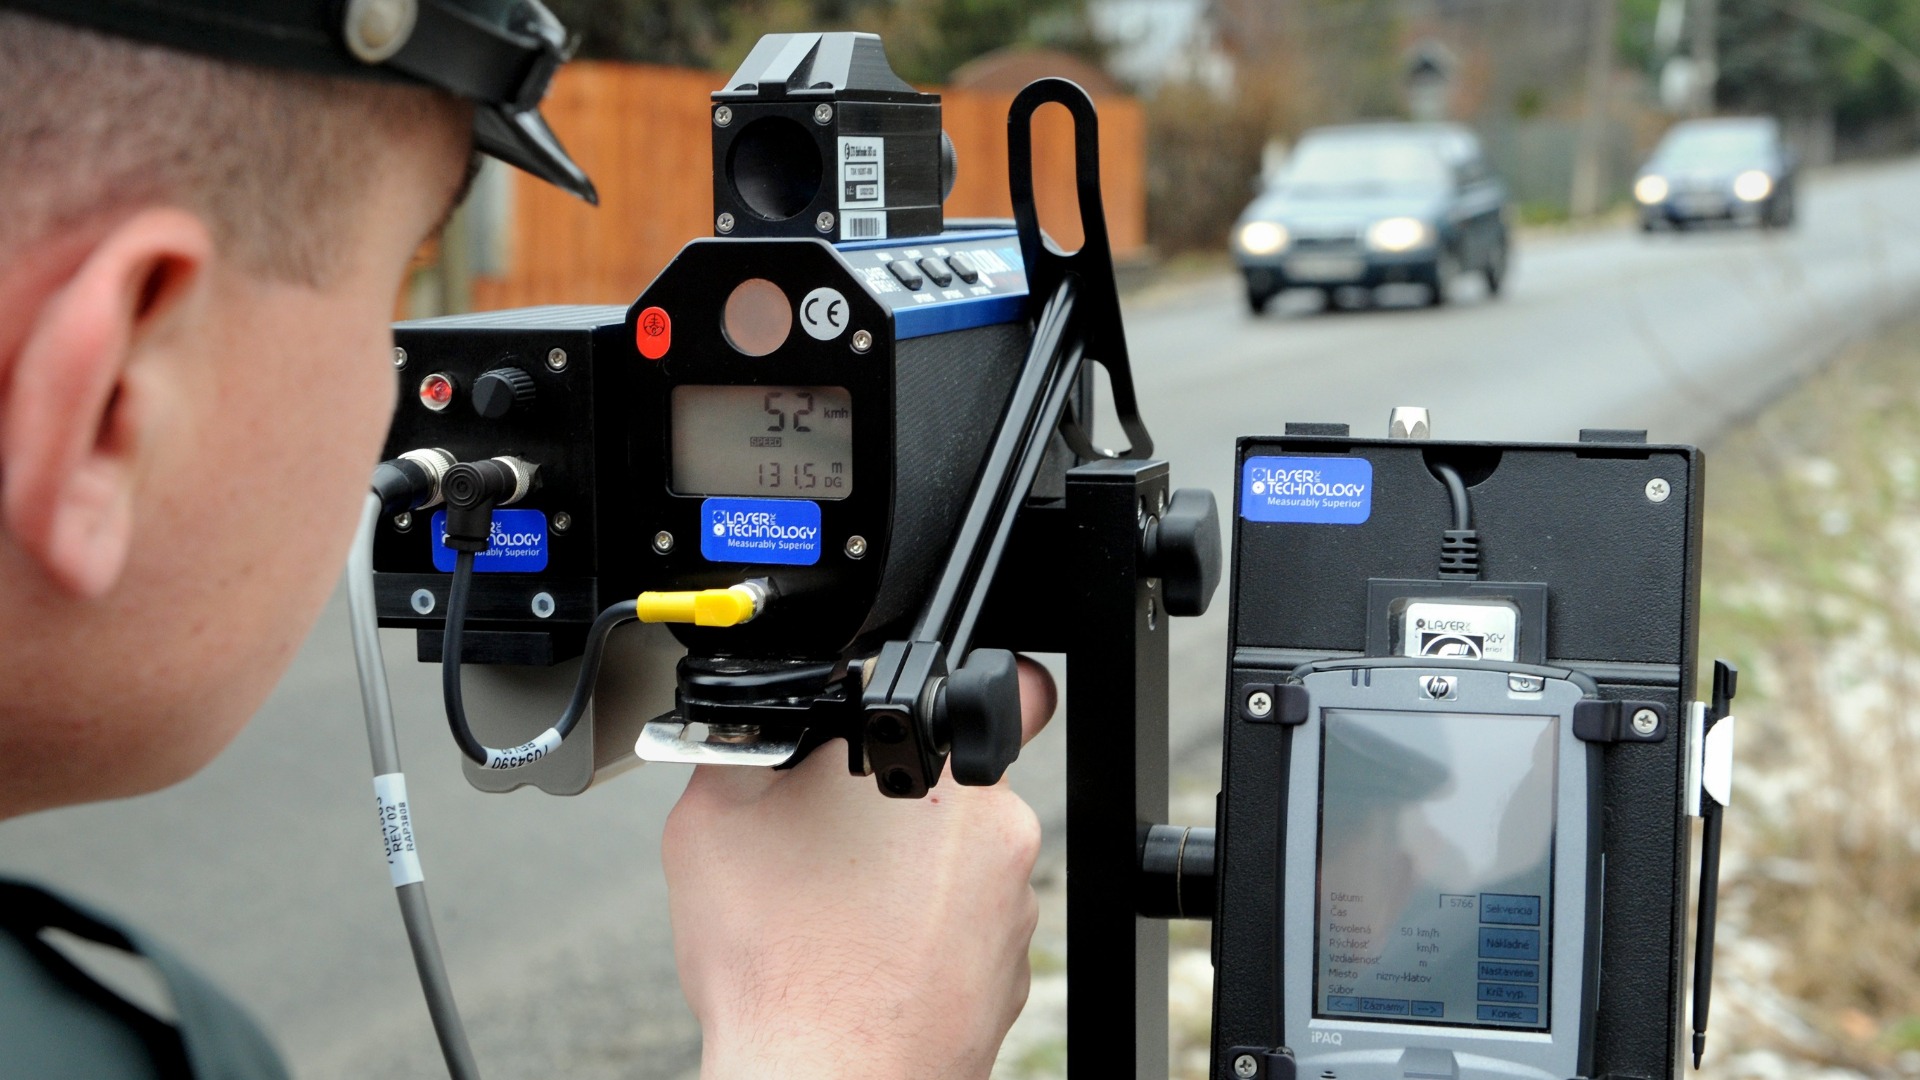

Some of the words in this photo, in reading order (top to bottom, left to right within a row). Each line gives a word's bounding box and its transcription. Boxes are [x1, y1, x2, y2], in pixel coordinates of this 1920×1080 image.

[805, 297, 841, 328] CE
[764, 391, 813, 432] 52
[823, 407, 848, 419] kmh
[750, 436, 782, 447] SPEED
[831, 461, 842, 474] m
[824, 476, 842, 488] DG
[1267, 469, 1314, 483] LASER
[1267, 481, 1365, 497] TECHNOLOGY
[1267, 497, 1320, 508] Measurably
[1322, 498, 1362, 509] Superior
[726, 511, 770, 525] LASER
[726, 524, 817, 539] TECHNOLOGY
[727, 538, 777, 550] Measurably
[778, 540, 815, 551] Superior
[505, 547, 540, 558] Superior
[1427, 620, 1466, 631] LASER
[385, 805, 397, 820] 02
[388, 825, 403, 853] REV
[1329, 923, 1372, 935] Povolená
[1401, 927, 1413, 937] 50
[1416, 927, 1440, 939] km/h
[1416, 942, 1440, 954] km/h
[1328, 968, 1359, 979] Miesto
[1481, 966, 1534, 978] Nastavenie
[1491, 1009, 1523, 1020] Koniec
[1311, 1031, 1343, 1046] iPAQ
